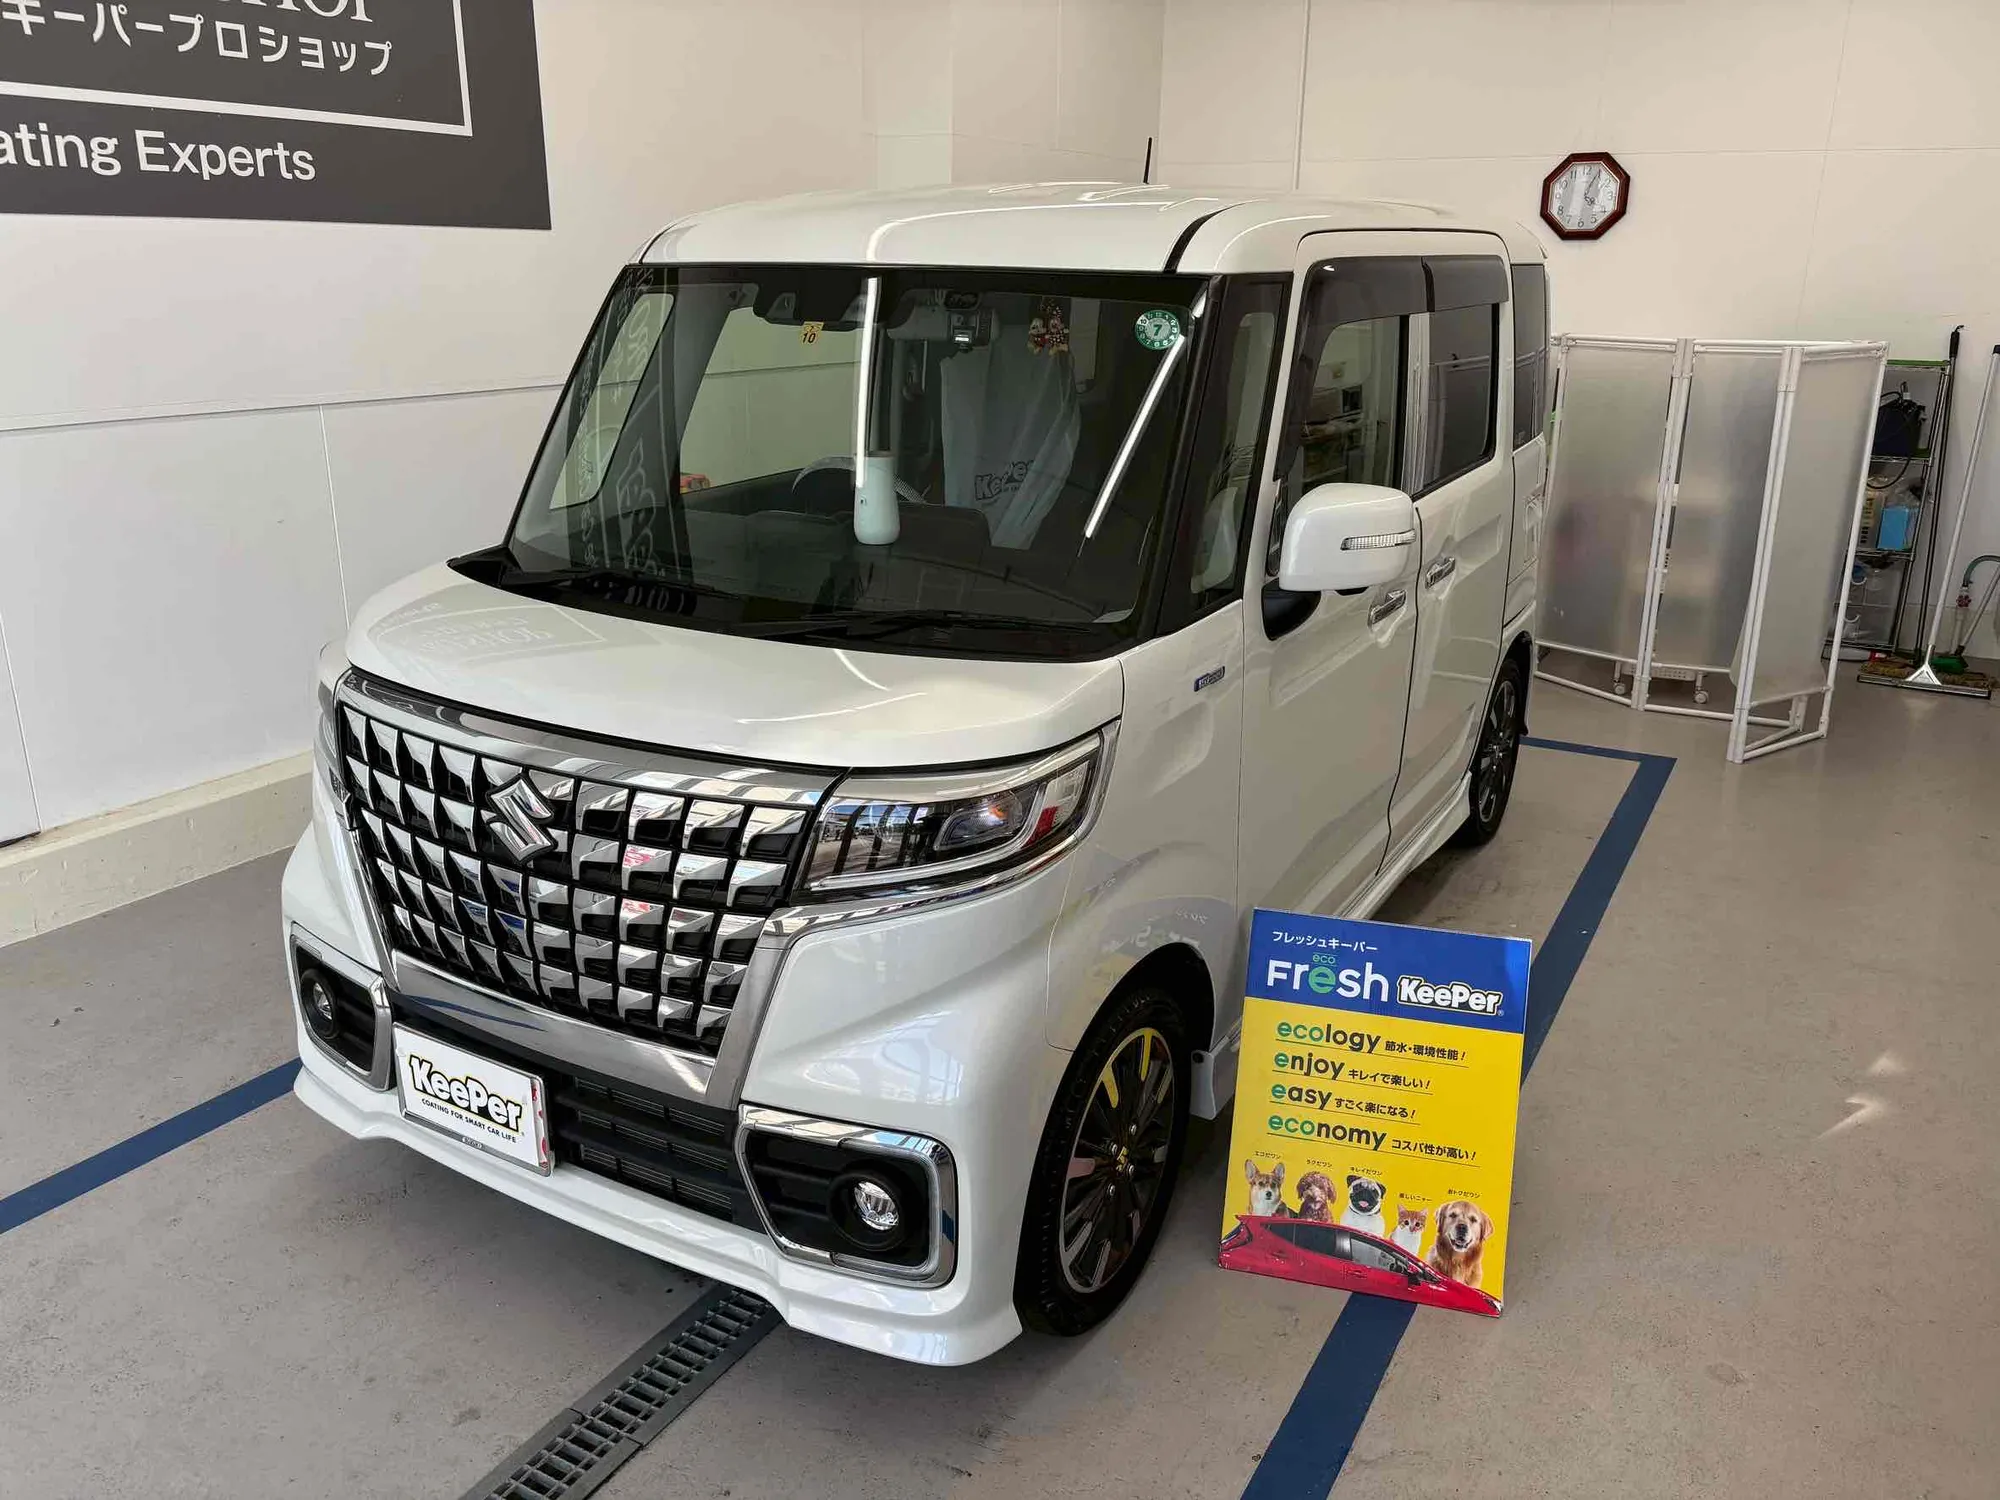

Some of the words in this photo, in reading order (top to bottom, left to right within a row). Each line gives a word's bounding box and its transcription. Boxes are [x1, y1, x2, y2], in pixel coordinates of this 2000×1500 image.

[1, 0, 392, 76] キーパープロショップ
[134, 128, 317, 181] Experts
[802, 331, 816, 344] 10
[1153, 324, 1162, 336] 7
[1312, 953, 1336, 965] eco
[1266, 959, 1389, 1003] Fresh
[1397, 975, 1502, 1015] KeePer
[1277, 1021, 1382, 1055] ecology
[1274, 1051, 1346, 1081] enjoy
[409, 1054, 522, 1132] KeePer
[1271, 1083, 1333, 1111] easy
[421, 1098, 449, 1115] COATING
[450, 1110, 464, 1121] FOR
[487, 1125, 501, 1137] CAR
[501, 1131, 517, 1144] LIFE
[1267, 1114, 1388, 1152] economy
